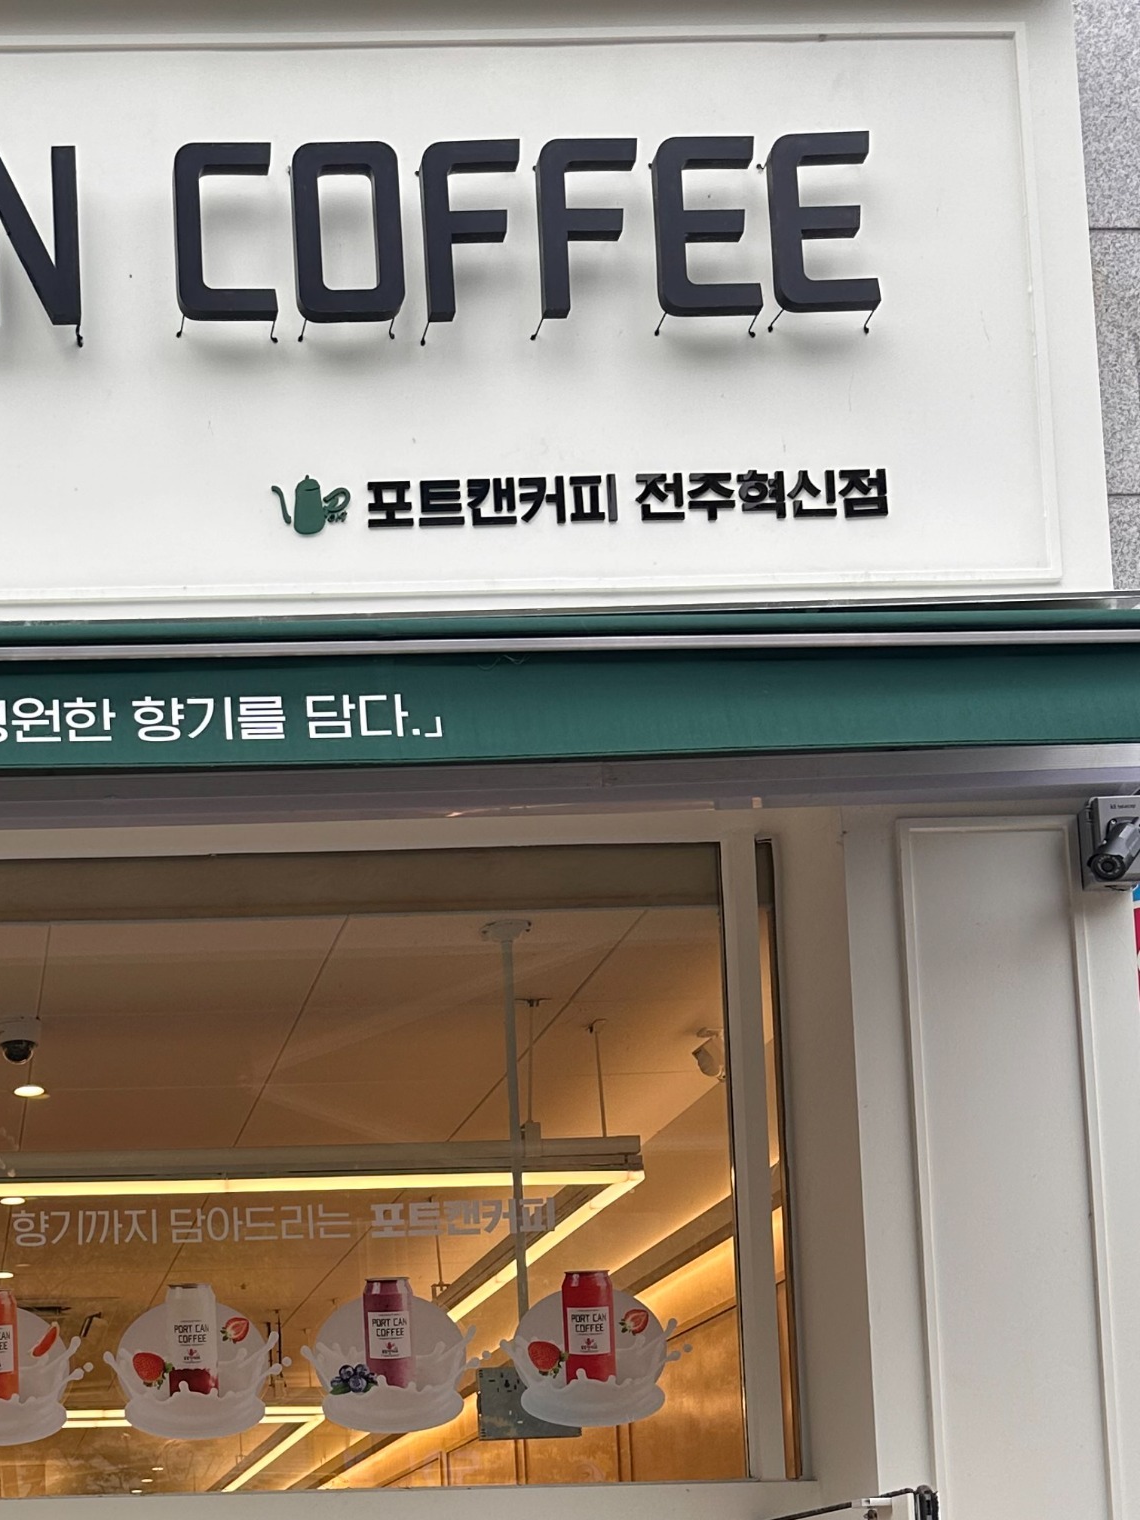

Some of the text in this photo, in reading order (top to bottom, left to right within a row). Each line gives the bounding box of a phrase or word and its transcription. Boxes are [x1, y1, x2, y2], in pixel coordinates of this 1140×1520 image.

[172, 130, 881, 323] COFFEE
[366, 467, 889, 529] 포트캔커피 전주혁신점
[132, 695, 286, 741] 향기를
[305, 693, 444, 739] 담다.」
[11, 1197, 555, 1247] 향기까지 담아드리는 포트캔커피
[372, 1318, 407, 1327] PORT CAN
[571, 1313, 607, 1323] PORT CAN
[174, 1324, 210, 1333] PORT CAN
[575, 1323, 604, 1332] COFFEE
[376, 1328, 405, 1337] COFFEE
[178, 1334, 207, 1343] COFFEE
